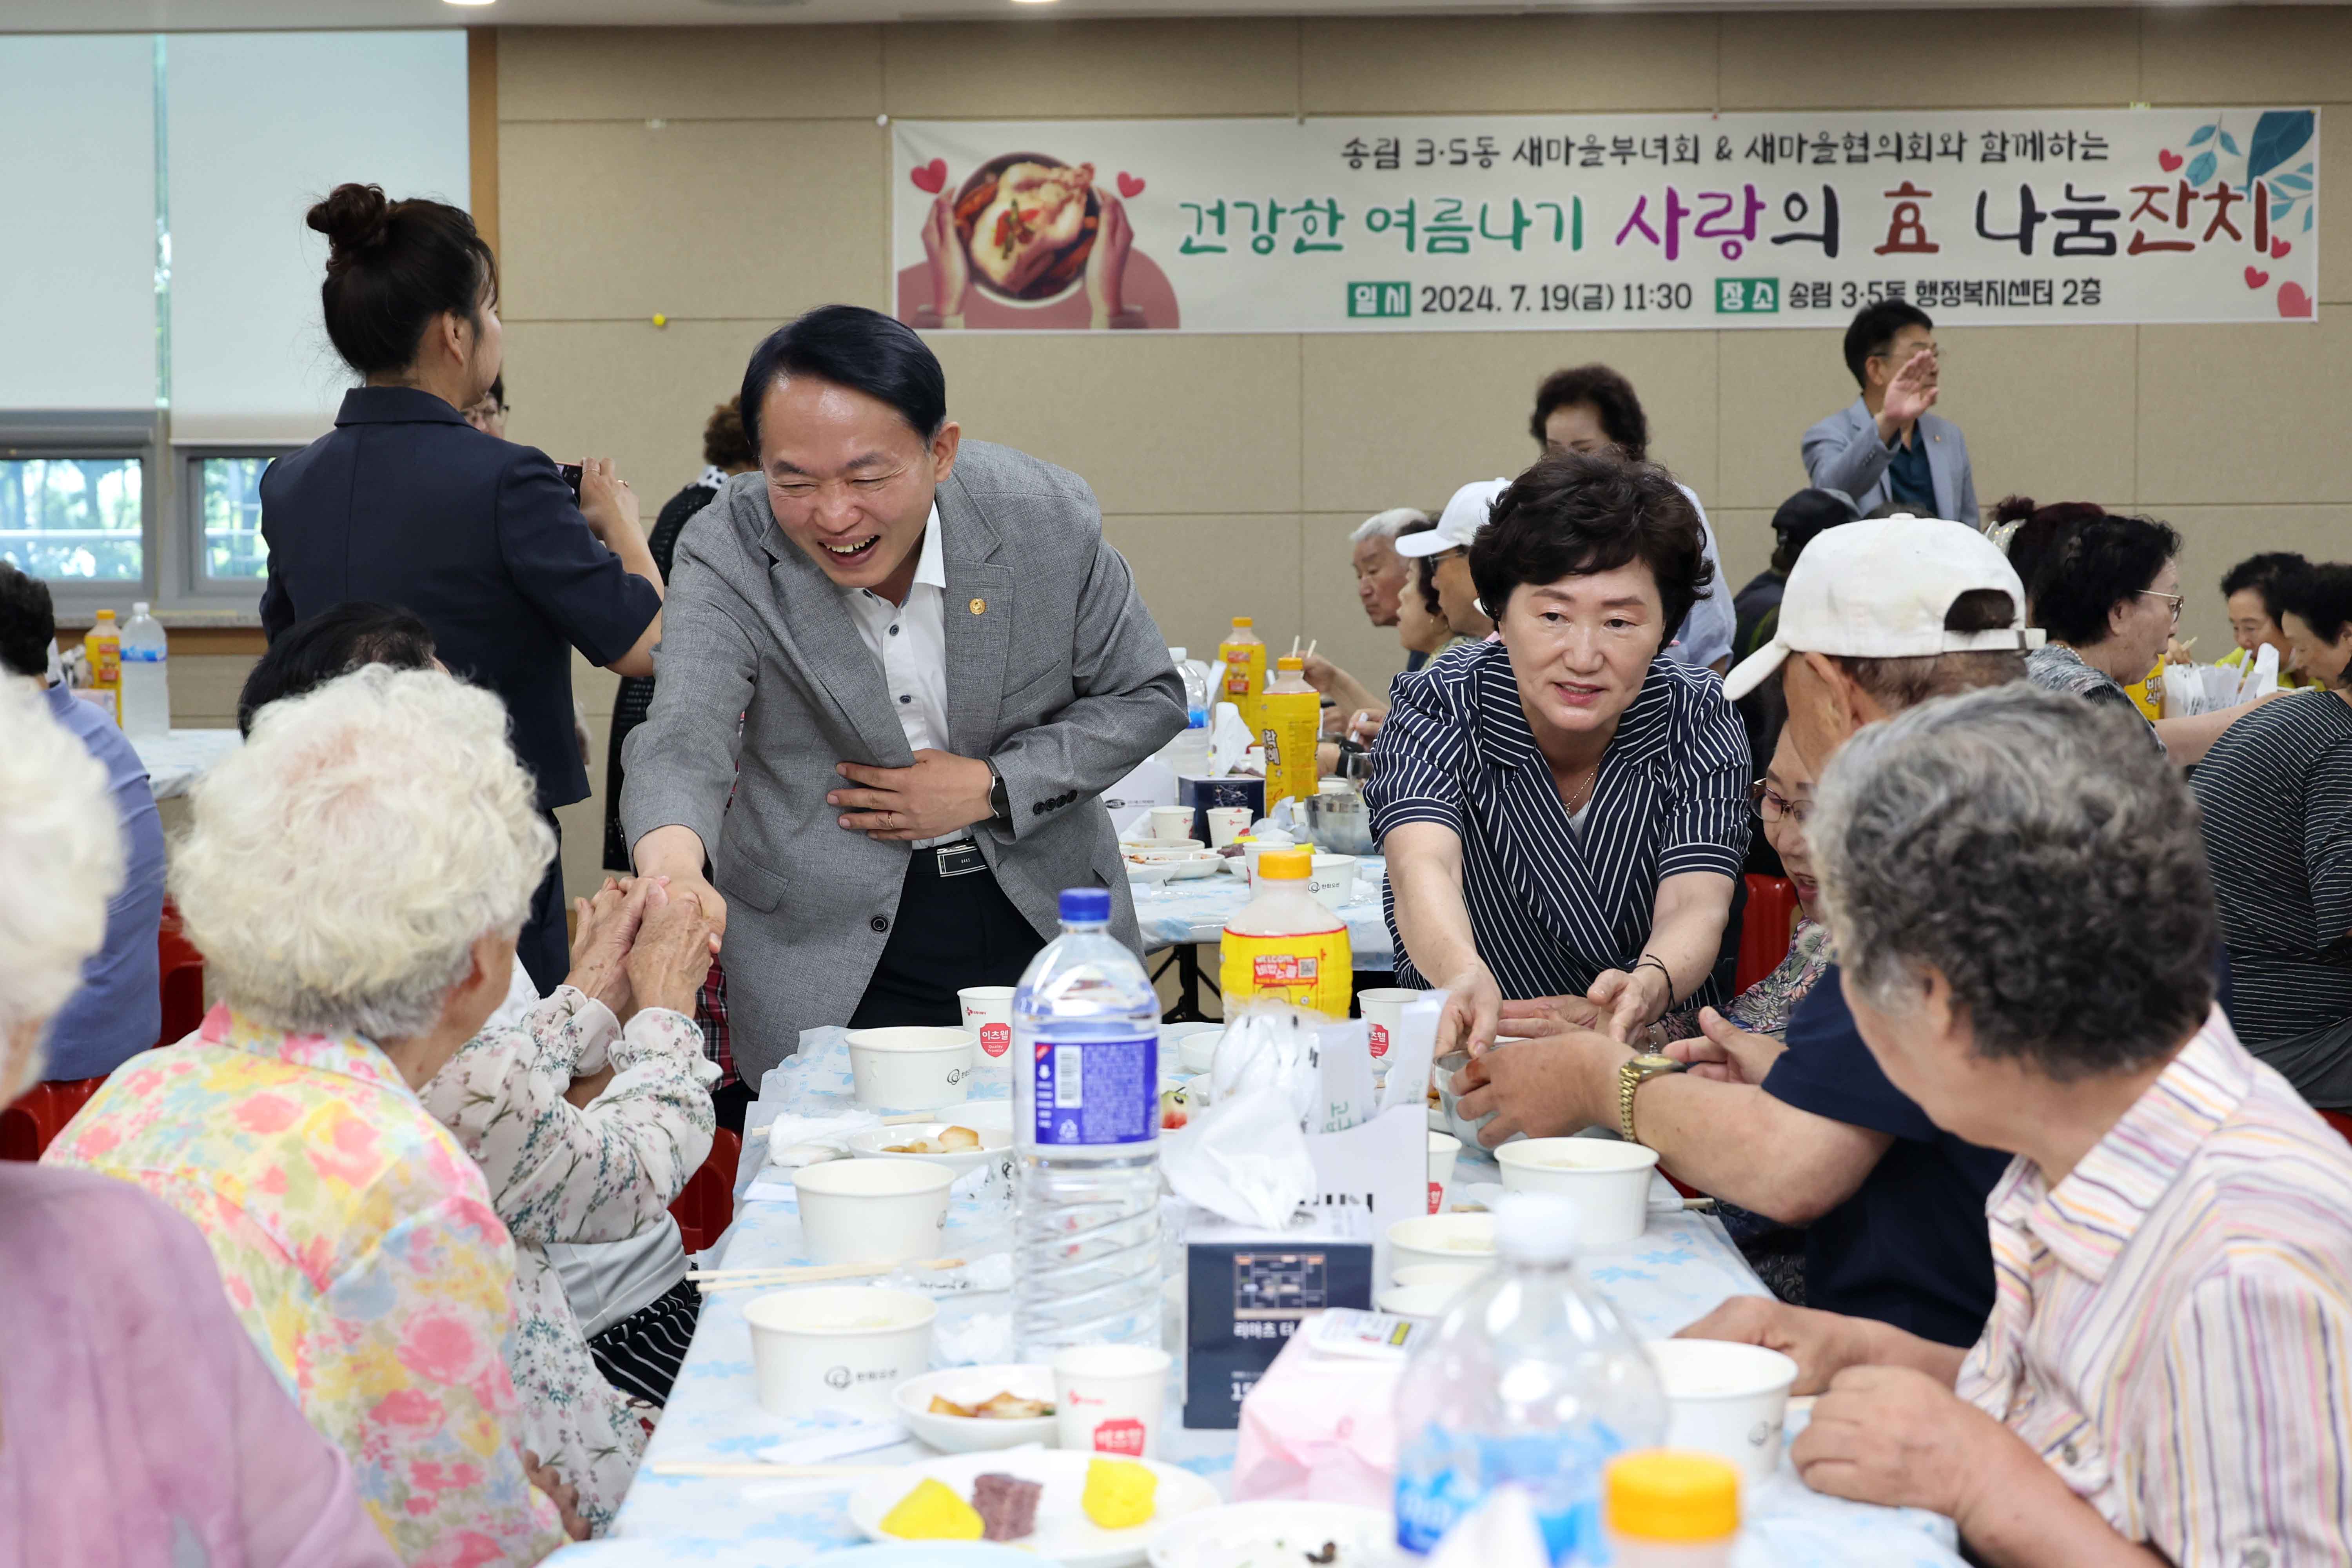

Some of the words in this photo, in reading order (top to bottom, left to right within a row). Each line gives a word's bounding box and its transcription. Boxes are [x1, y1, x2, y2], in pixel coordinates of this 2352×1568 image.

[1341, 137, 1400, 169] 송림
[1512, 134, 1699, 168] 새마을부녀회
[1715, 135, 1732, 161] &
[1744, 130, 1967, 165] 새마을협의회와
[1980, 130, 2109, 163] 함께하는
[1180, 198, 1345, 255] 건강한
[1366, 195, 1583, 254] 여름나기
[1615, 183, 1839, 260] 사랑의
[1873, 180, 1940, 255] 효
[1624, 282, 1692, 310] 11:30
[1789, 281, 1831, 309] 송림
[1916, 279, 2053, 307] 행정복지센터
[2062, 277, 2101, 306] 2층
[982, 1029, 1009, 1041] 이츠웰
[1370, 1031, 1387, 1043] 츠웰
